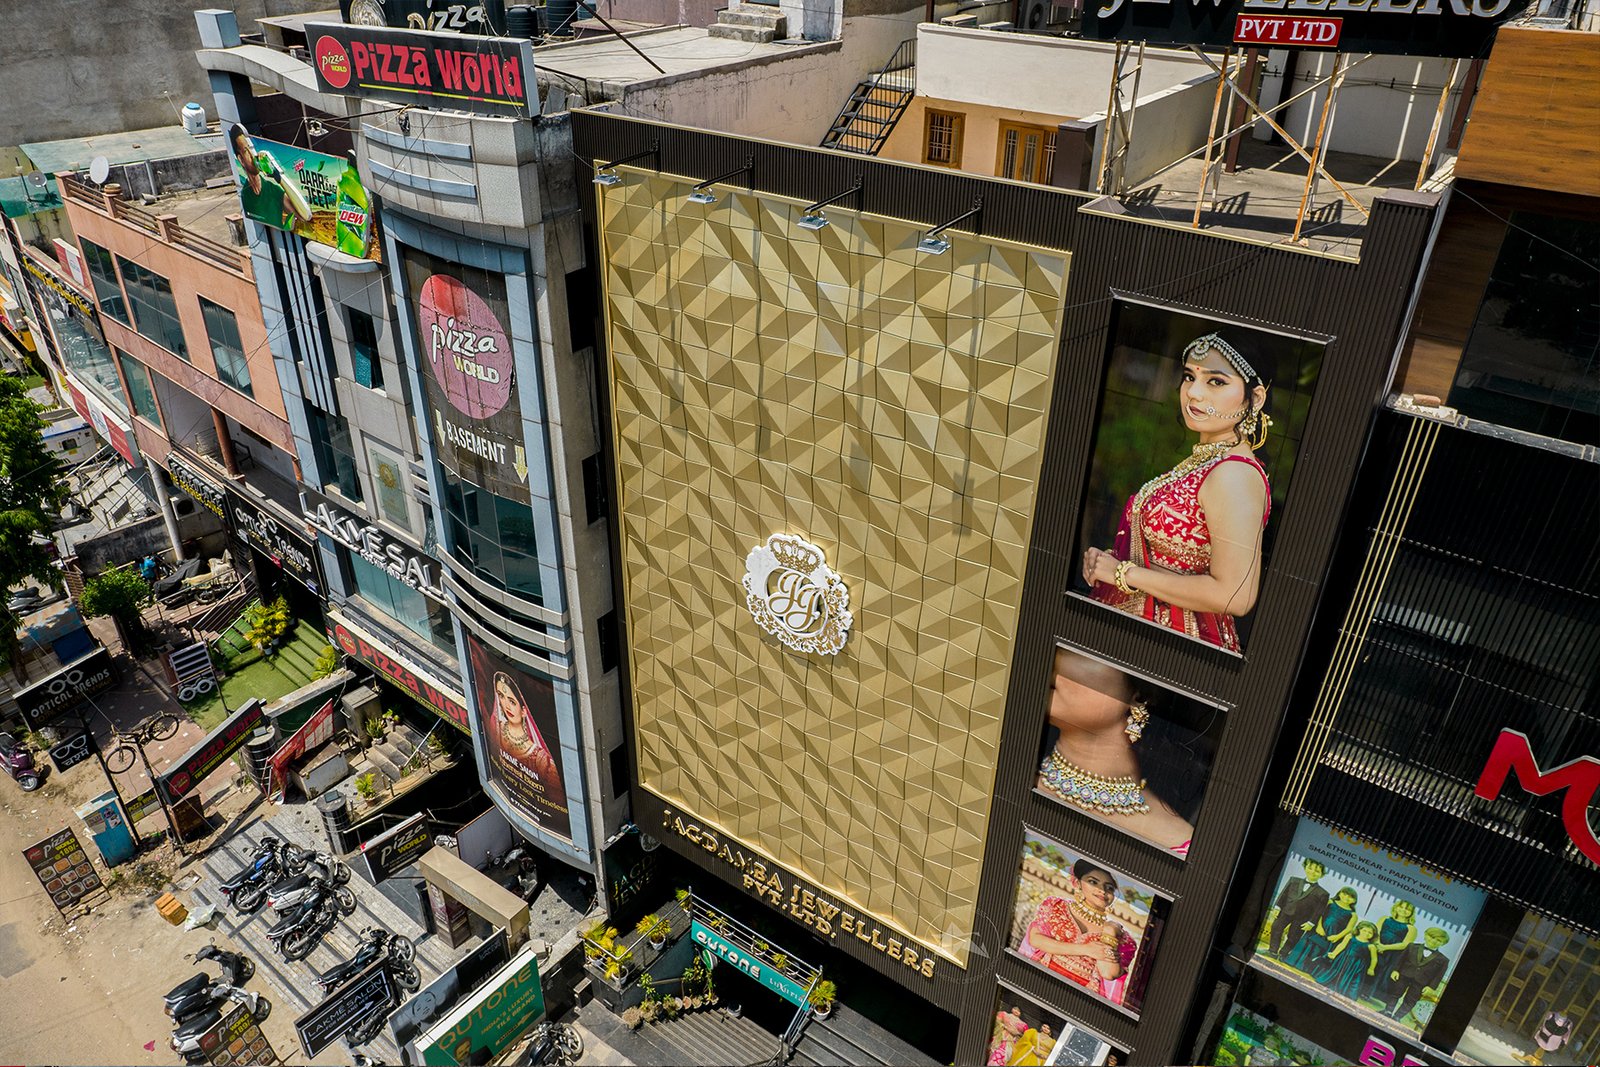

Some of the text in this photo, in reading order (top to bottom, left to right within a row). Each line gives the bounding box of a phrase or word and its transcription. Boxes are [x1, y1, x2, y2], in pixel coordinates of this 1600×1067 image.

[1238, 18, 1338, 42] PVT LTD
[431, 317, 499, 364] pizza
[453, 354, 500, 385] WORLD
[446, 420, 506, 466] BASEMENT
[235, 507, 312, 574] OPTICAL TRENDS
[30, 690, 73, 718] OPTICAL
[397, 833, 427, 854] WORLD
[1308, 844, 1459, 913] SMART CASUAL BIRTHDAY EDITION
[1326, 843, 1446, 898] ETHNIC WEAR PARTY WEAR
[790, 883, 936, 978] JEWELLERS
